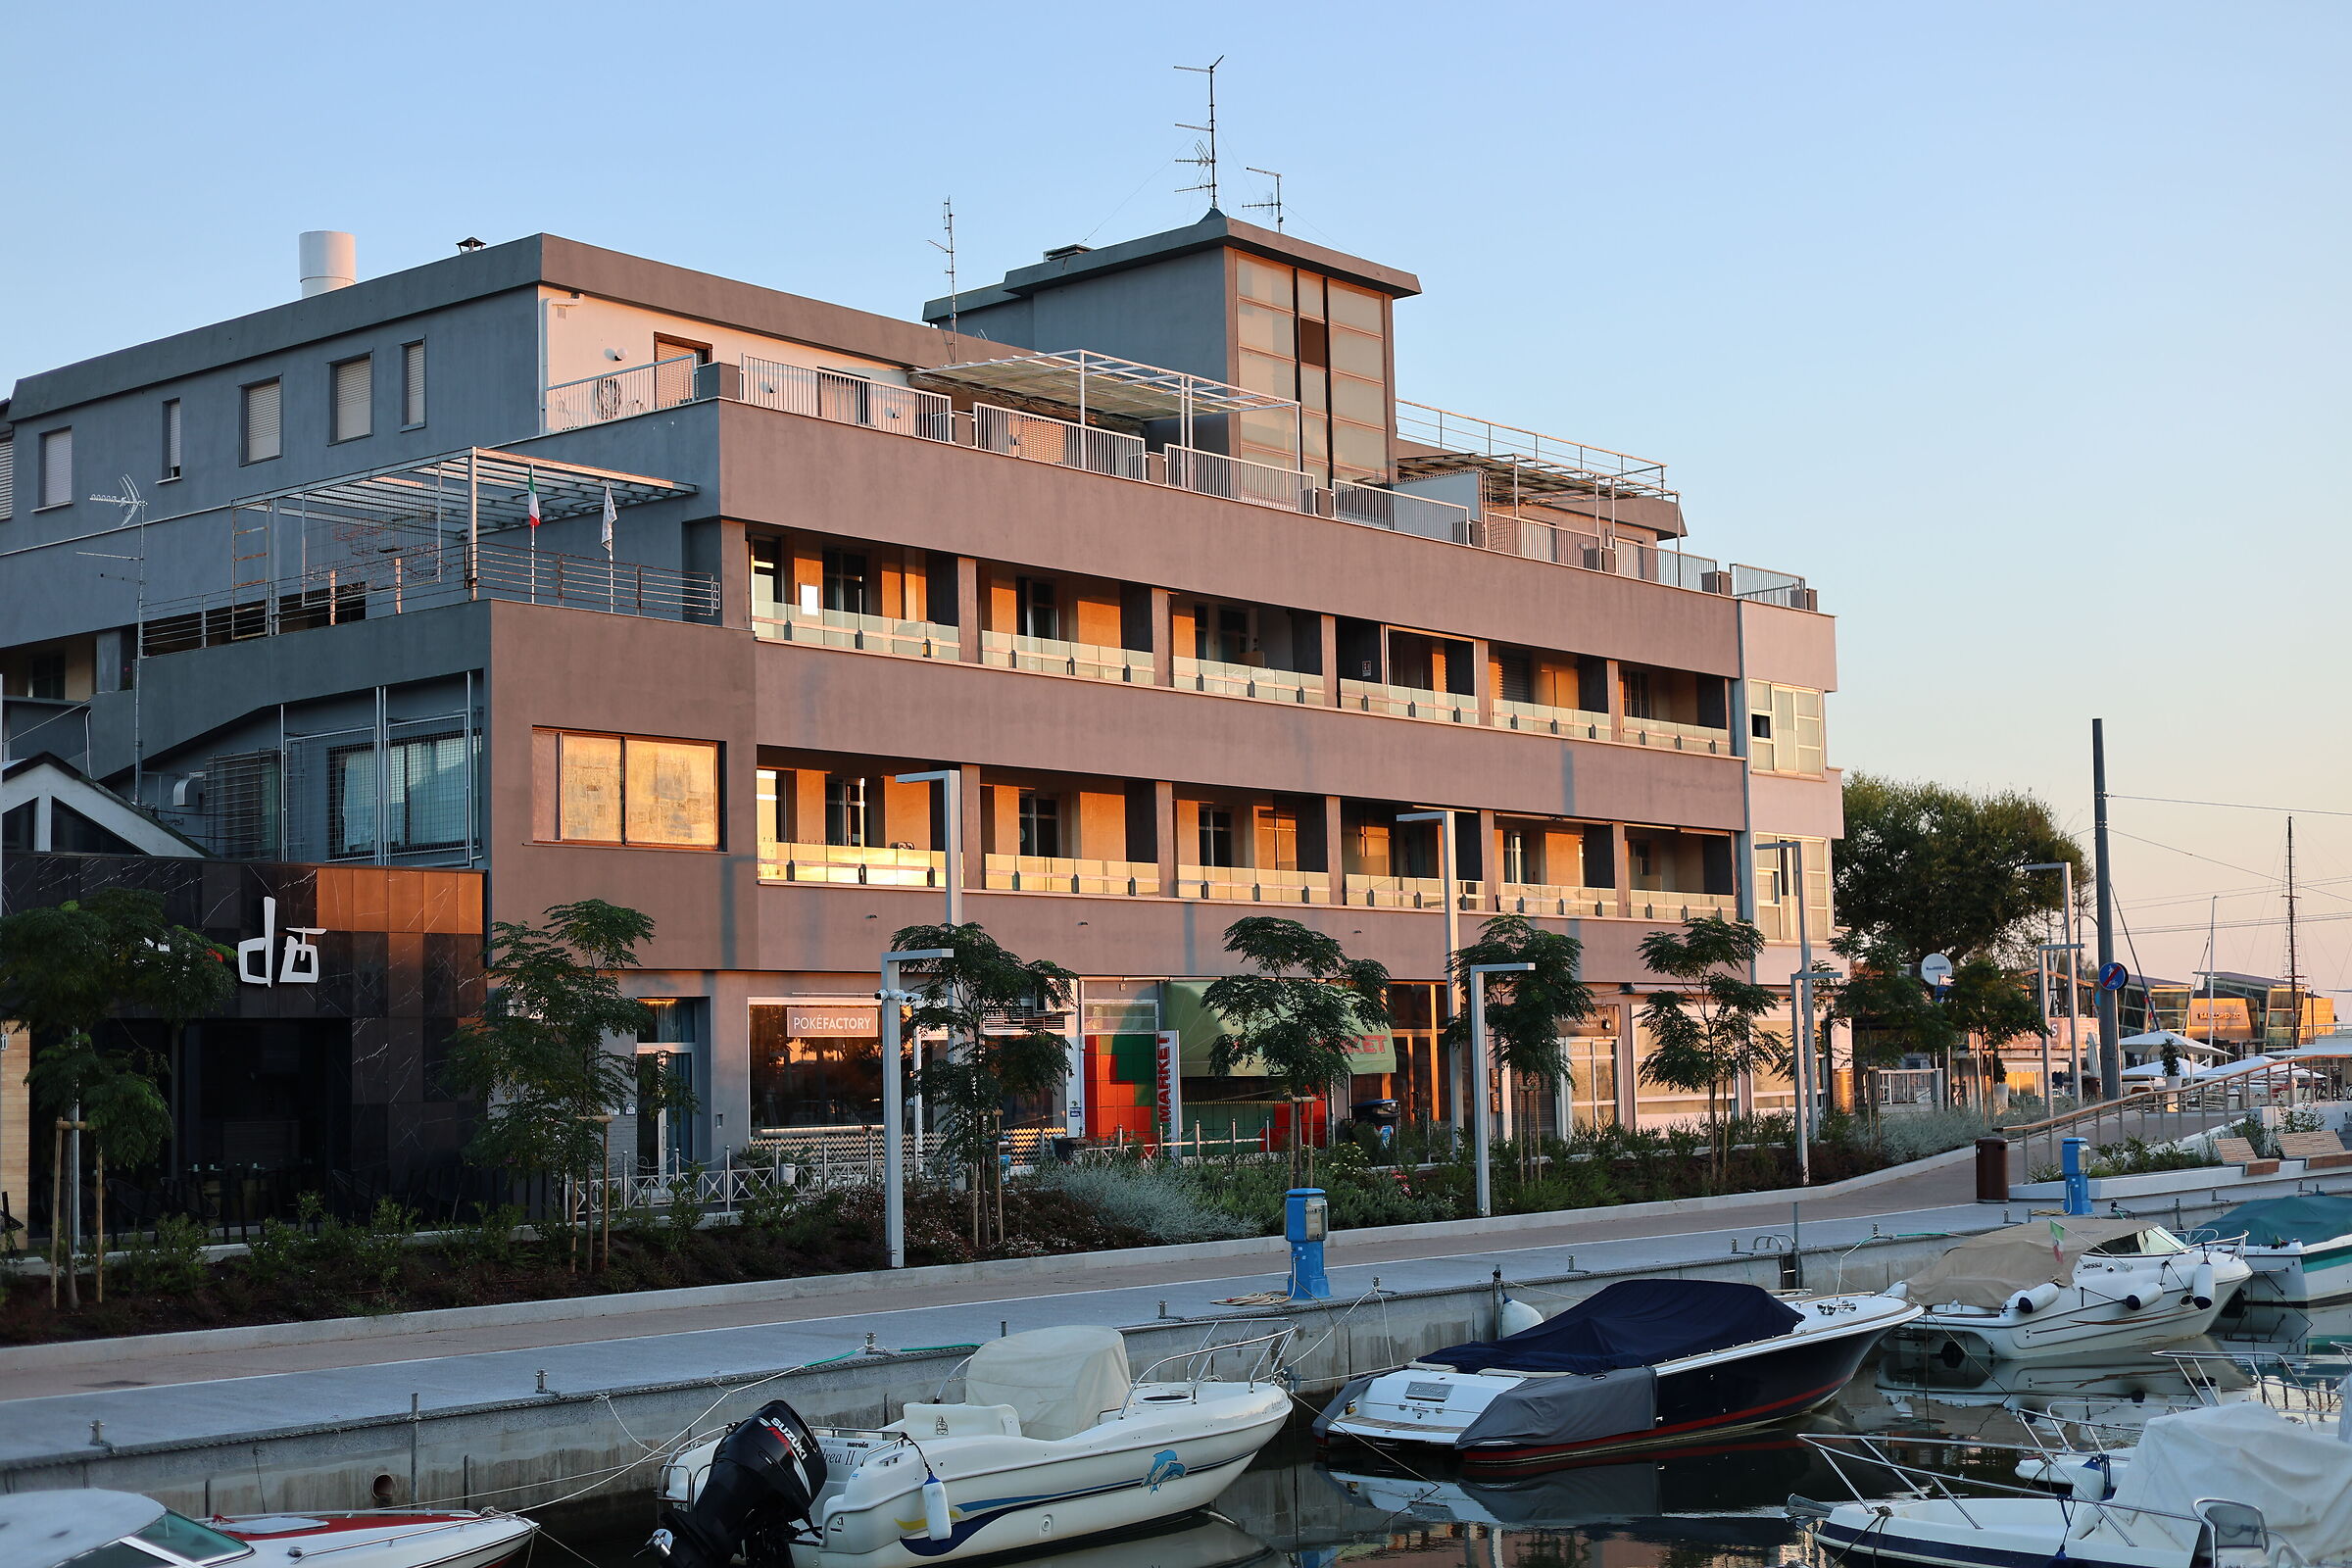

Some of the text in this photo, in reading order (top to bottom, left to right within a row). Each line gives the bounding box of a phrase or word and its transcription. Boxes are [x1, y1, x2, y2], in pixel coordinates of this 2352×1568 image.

[793, 1013, 871, 1030] POKÉFACTORY
[1157, 1034, 1171, 1123] MARKET
[770, 1417, 808, 1460] SUZUKI
